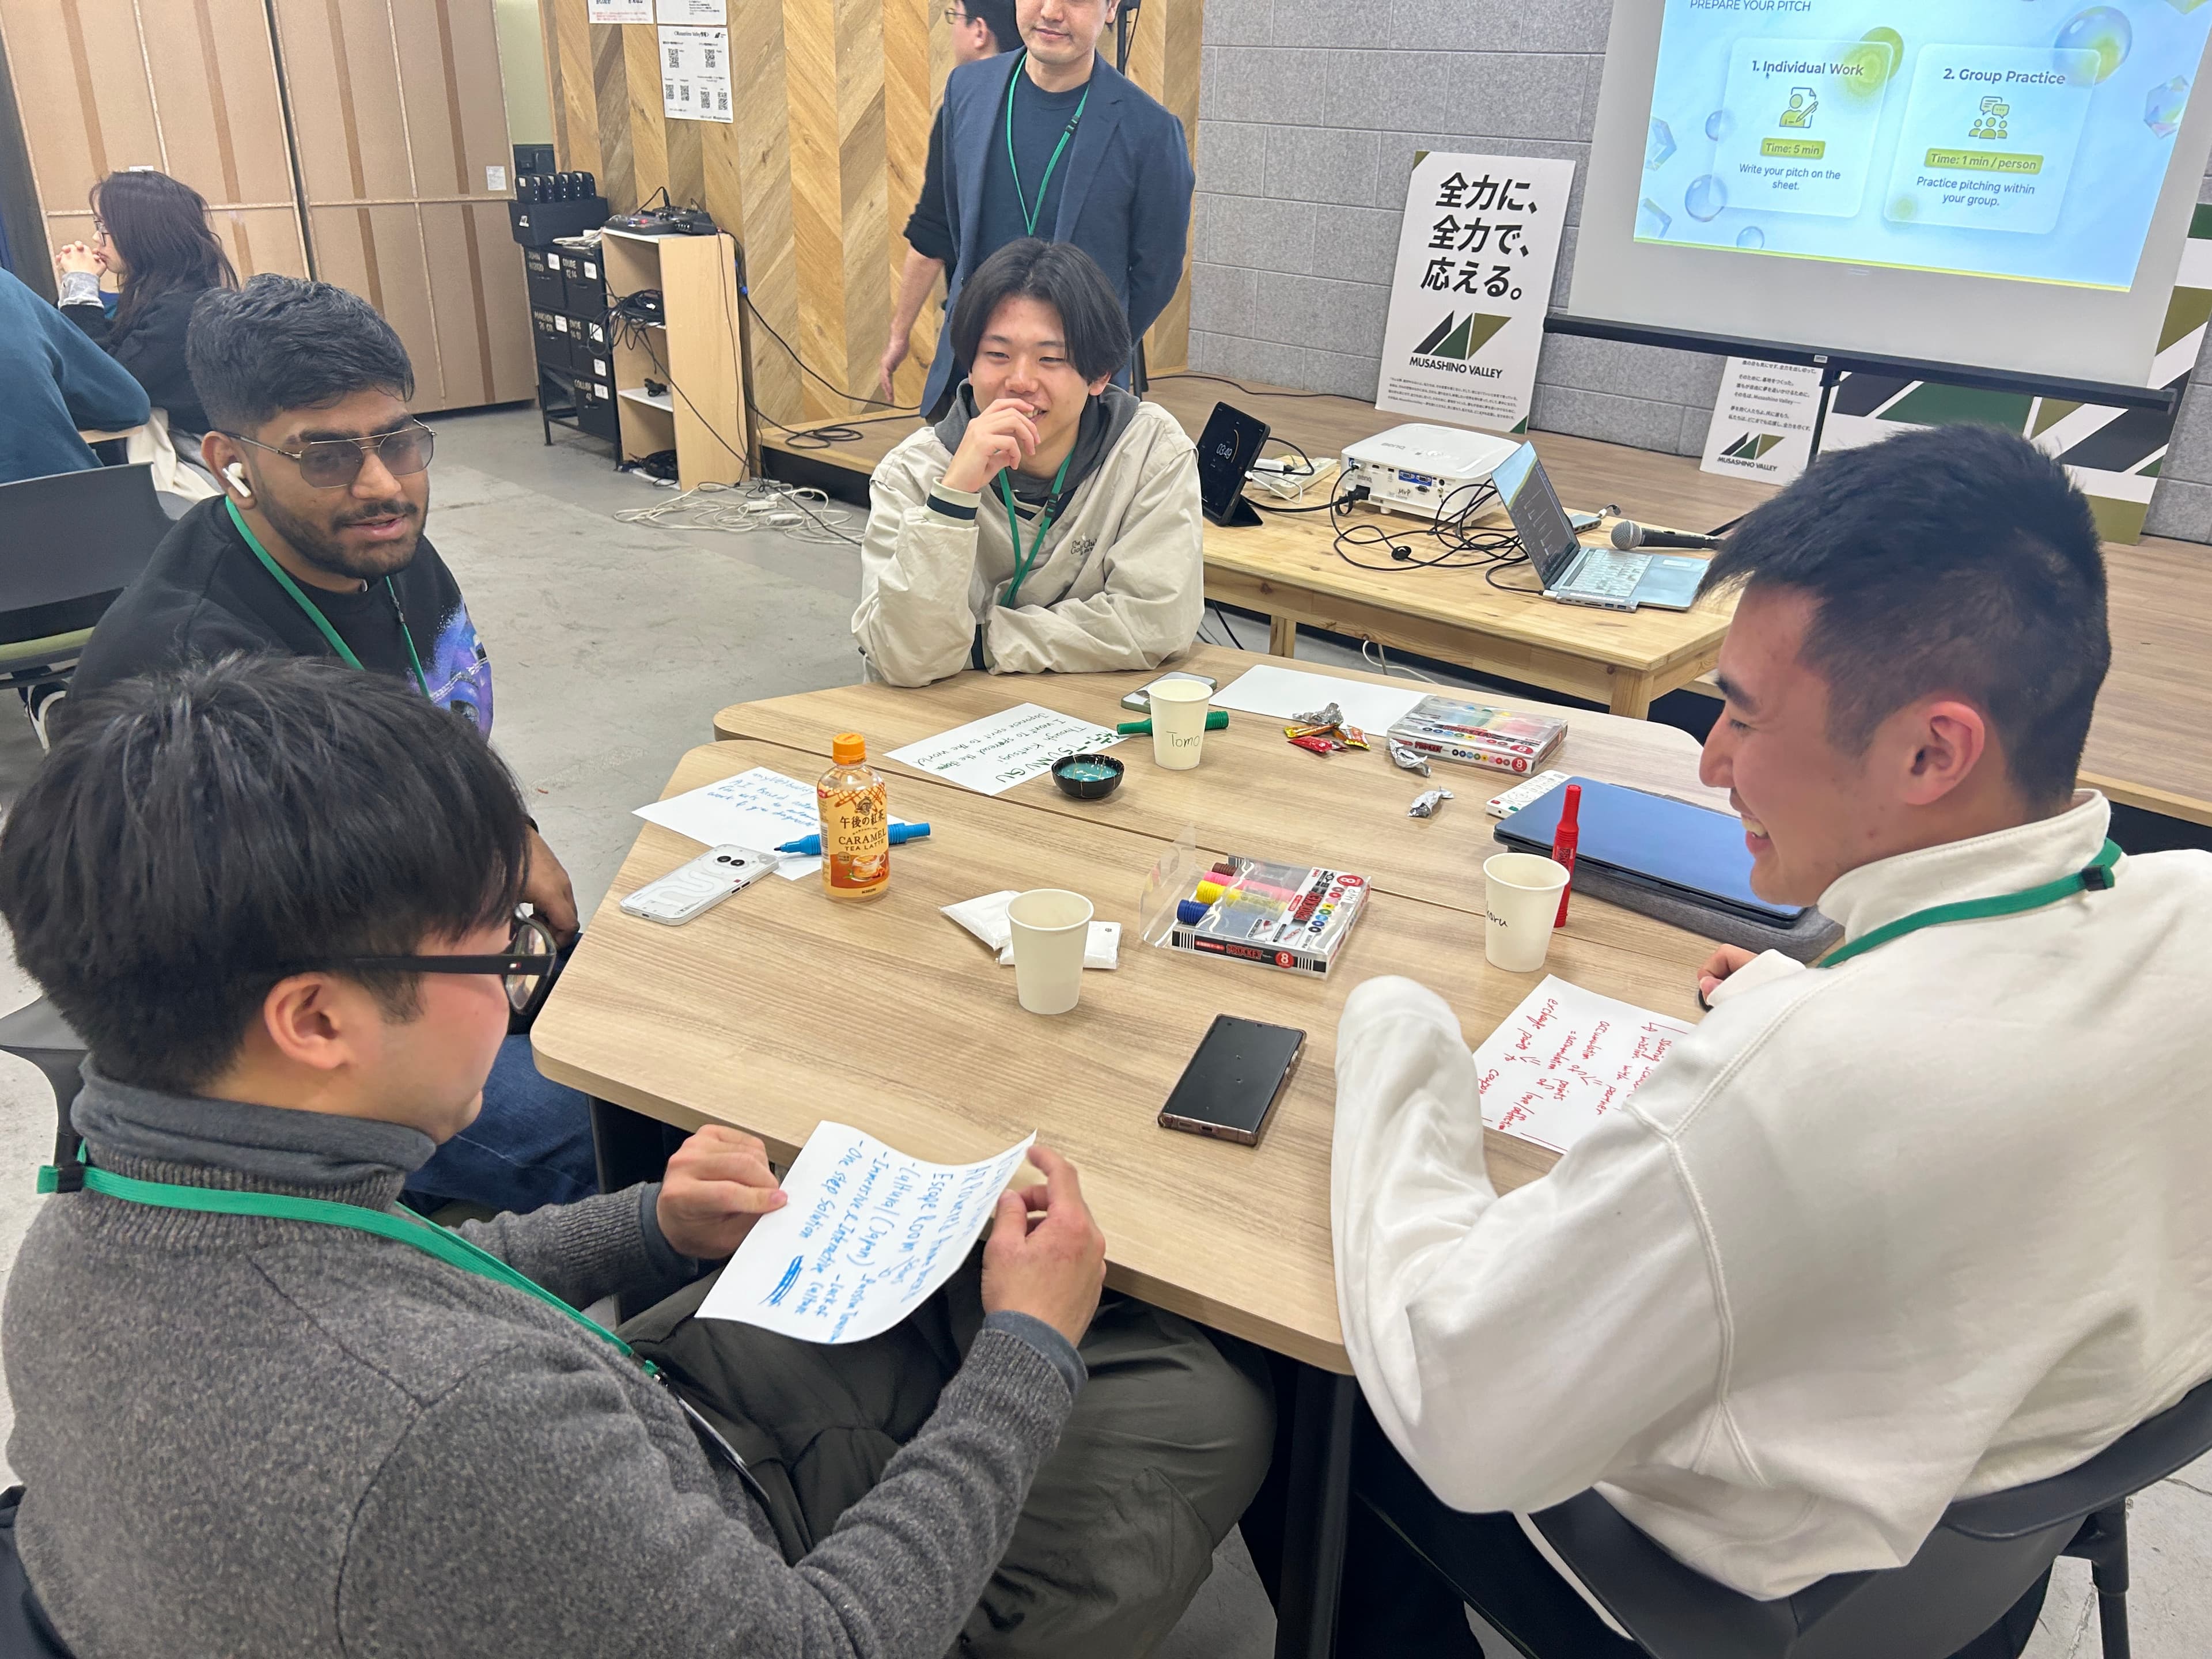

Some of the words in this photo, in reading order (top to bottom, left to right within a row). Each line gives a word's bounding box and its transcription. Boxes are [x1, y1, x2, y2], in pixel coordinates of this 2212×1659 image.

[1690, 0, 1740, 10] PREPARE
[1744, 1, 1774, 10] YOUR
[1777, 1, 1811, 12] PITCH
[1752, 60, 1760, 71] 1.
[1763, 60, 1825, 75] Individual
[1829, 63, 1864, 76] Work
[1943, 68, 1955, 79] 2.
[1959, 69, 2002, 84] Group
[2006, 71, 2066, 85] Practice
[1766, 143, 1791, 154] Time:
[1793, 145, 1801, 154] 5
[1801, 145, 1820, 156] min
[1931, 153, 1960, 165] Time:
[1963, 156, 1968, 165] 1
[1969, 156, 1989, 167] min
[1990, 157, 1998, 168] /
[1998, 159, 2037, 170] person
[1739, 164, 1762, 175] Write
[1764, 167, 1784, 177] your
[1785, 166, 1809, 179] pitch
[1811, 169, 1824, 178] on
[1825, 170, 1841, 180] the
[1435, 172, 1538, 214] 全力に、
[1772, 179, 1800, 191] sheet.
[1916, 176, 1957, 188] Practice
[1960, 179, 2001, 194] pitching
[2003, 183, 2035, 194] within
[1942, 194, 1965, 204] your
[1967, 196, 2000, 207] group.
[1427, 214, 1529, 257] 全力で、
[1419, 256, 1522, 300] 応える。
[1409, 356, 1467, 374] MUSASHINO
[1469, 364, 1503, 379] VALLEY
[1717, 456, 1755, 468] MUSASHINO
[1756, 462, 1778, 472] VALLEY
[1034, 721, 1055, 733] want
[1043, 726, 1088, 741] Through
[950, 743, 966, 752] the
[1166, 730, 1200, 748] Tomo
[918, 750, 952, 767] world
[959, 753, 977, 762] the
[1516, 759, 1522, 768] 8
[840, 809, 885, 830] 午後の紅茶
[838, 828, 887, 845] CARAMEL
[864, 839, 884, 851] LATTE
[1344, 889, 1357, 902] MVP
[1293, 891, 1324, 921] PROCKEY
[1226, 944, 1264, 960] PROCKEY
[1280, 953, 1289, 964] 8
[1527, 998, 1559, 1030] exchange
[1553, 1078, 1569, 1101] points
[1596, 1084, 1616, 1115] partner
[838, 1147, 862, 1168] One
[917, 1172, 954, 1210] Escape
[798, 1198, 835, 1239] Solution
